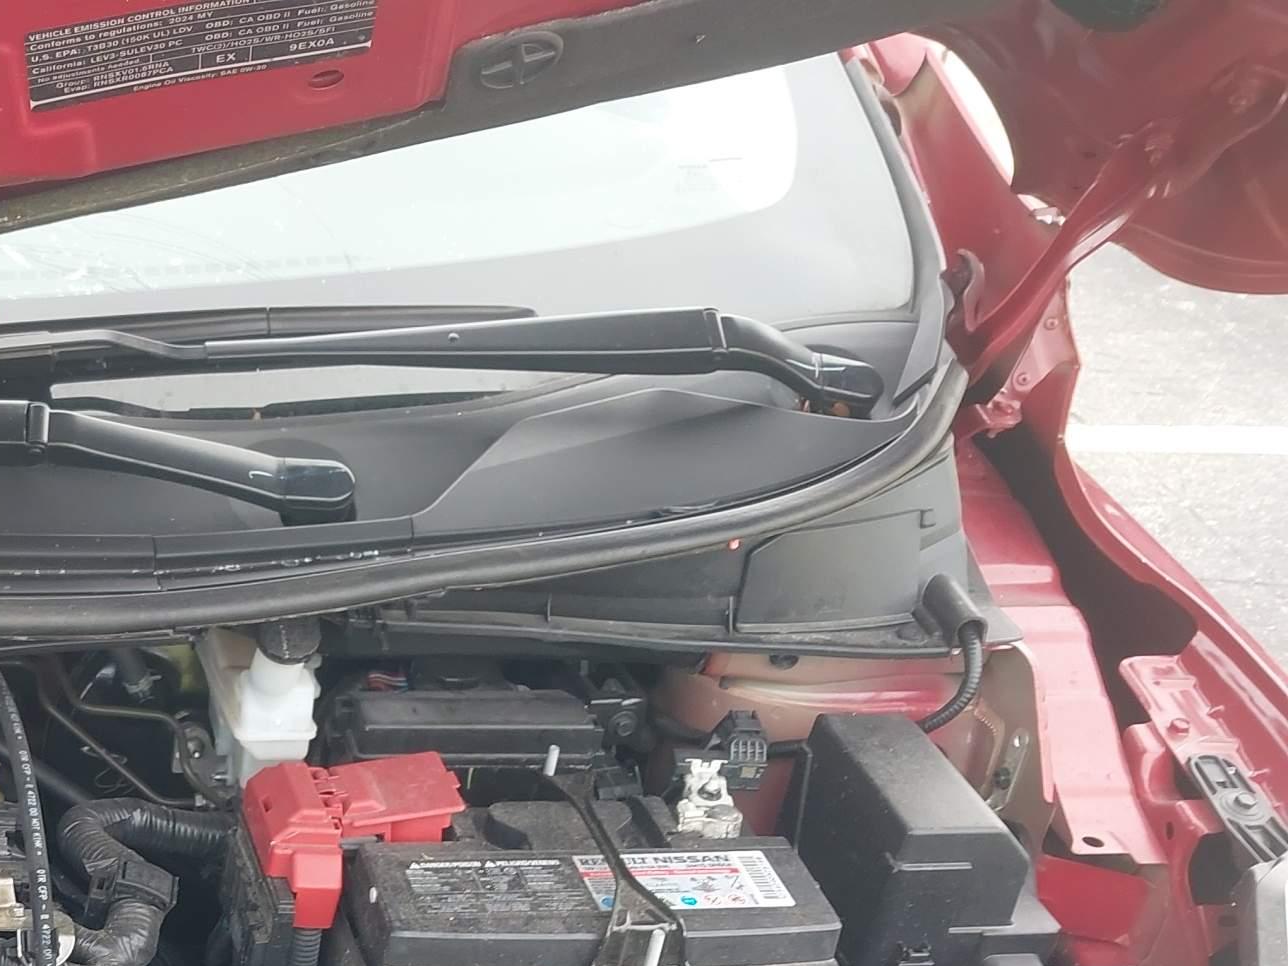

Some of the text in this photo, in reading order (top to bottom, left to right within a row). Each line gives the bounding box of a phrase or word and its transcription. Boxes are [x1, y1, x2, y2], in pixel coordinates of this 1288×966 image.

[28, 0, 253, 42] VEHICLE EMISSION CONTROL INFORMATION
[204, 31, 233, 41] OBD:
[238, 27, 253, 36] CA
[256, 24, 280, 34] OBD
[297, 19, 324, 28] Fuel:
[329, 10, 374, 23] Gasoline
[205, 20, 234, 29] OBD:
[238, 16, 255, 24] CA
[257, 12, 281, 22] OBD
[330, 0, 376, 12] Gasoline
[29, 11, 214, 51] Conforms to regulations: 2024 MY
[31, 53, 53, 63] U.S.
[55, 46, 81, 59] EPA:
[32, 60, 86, 75] California:
[168, 39, 183, 48] PC
[215, 52, 237, 63] EX
[63, 84, 91, 94] Evap:
[133, 80, 162, 92] Engine
[654, 855, 730, 863] NISSAN
